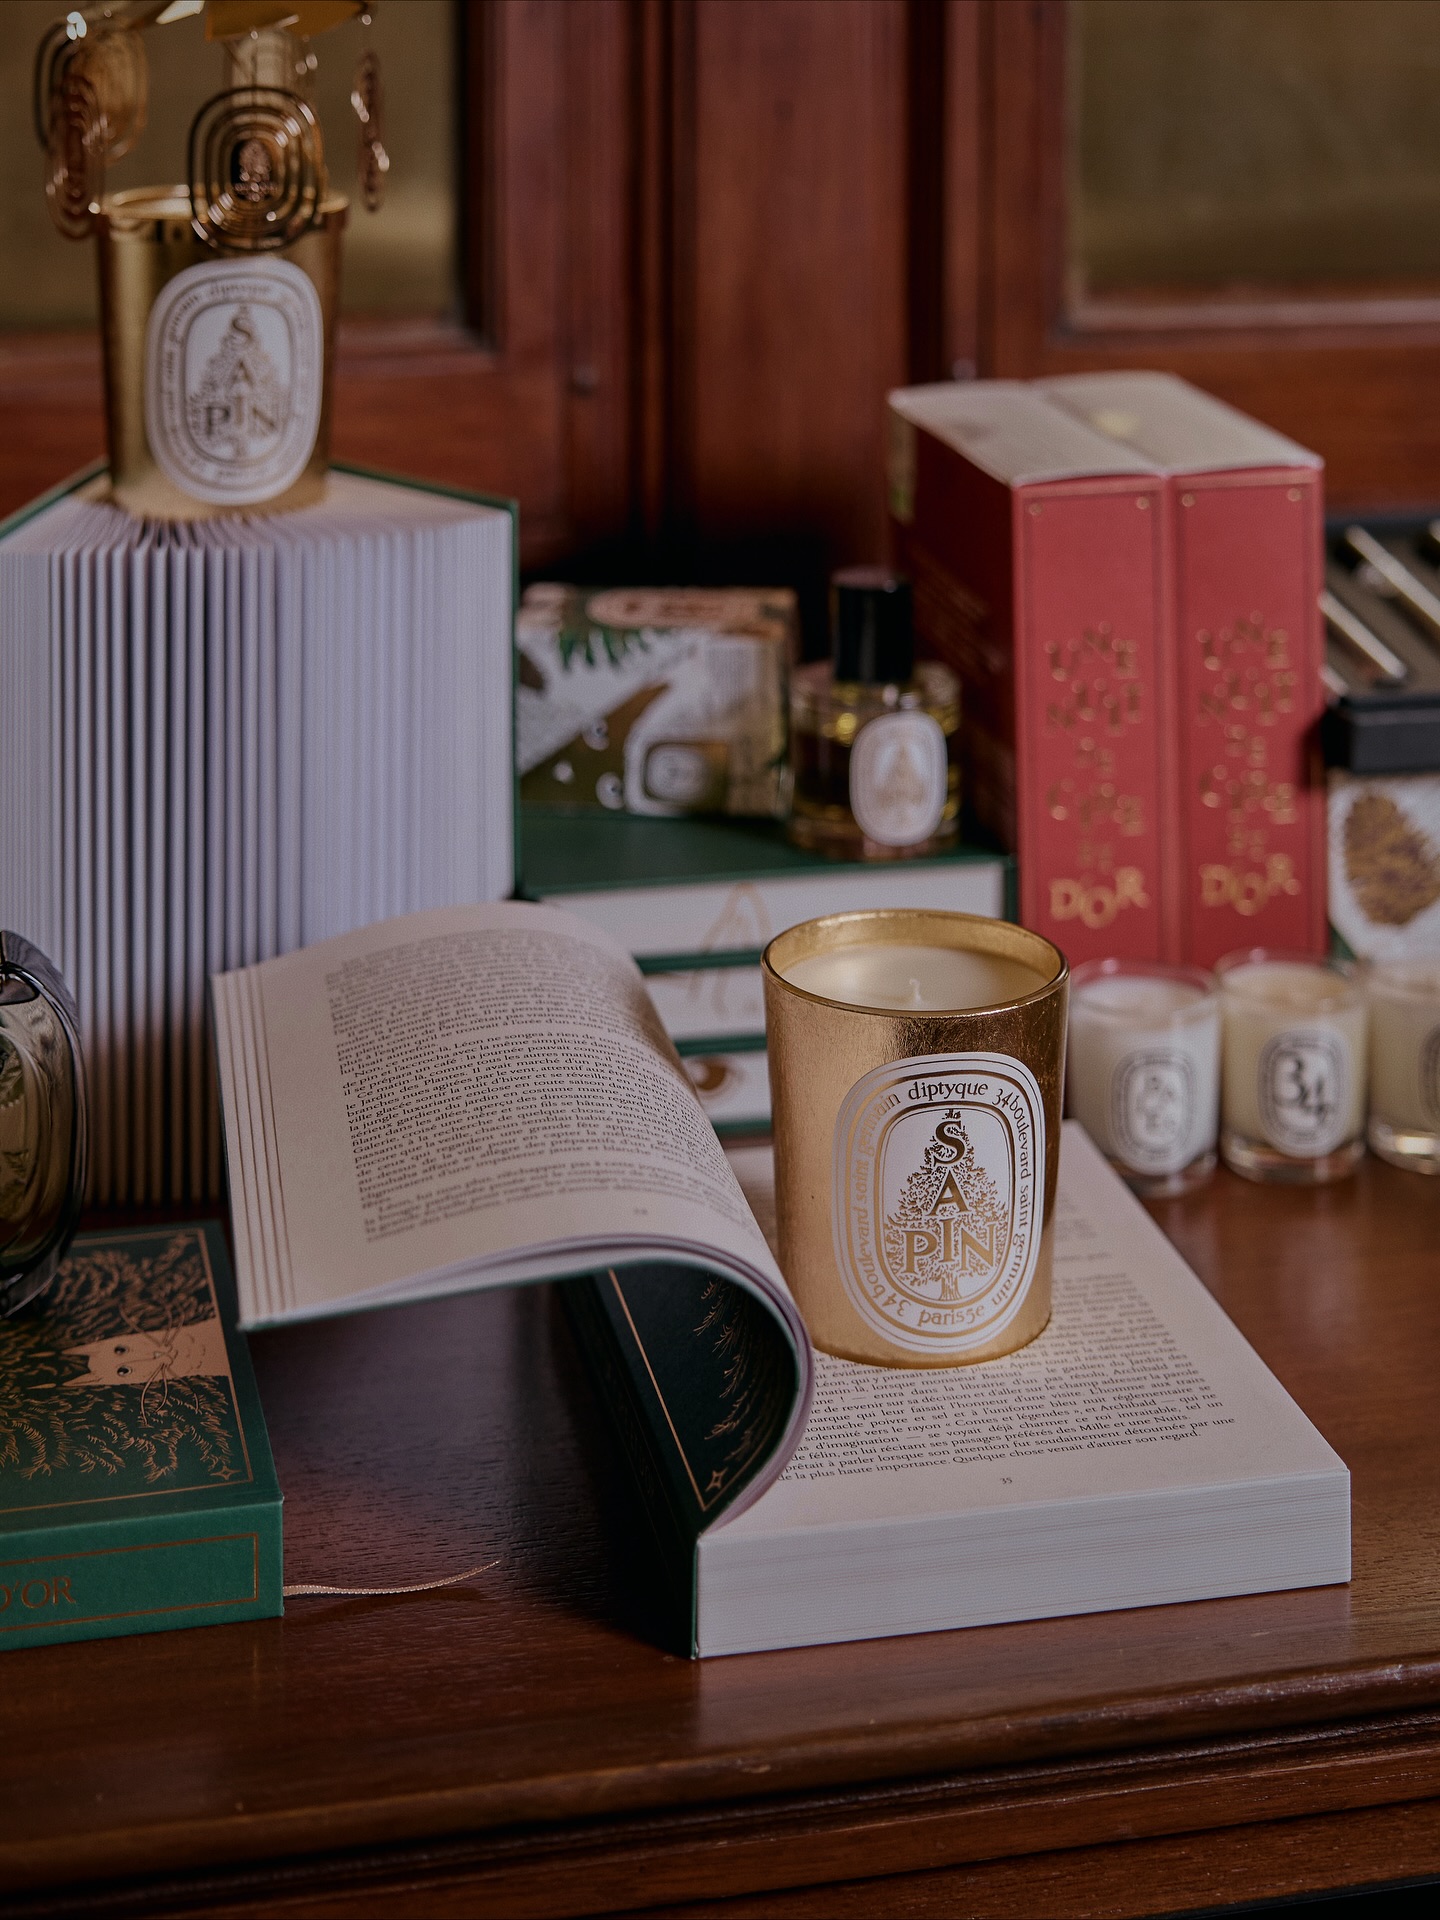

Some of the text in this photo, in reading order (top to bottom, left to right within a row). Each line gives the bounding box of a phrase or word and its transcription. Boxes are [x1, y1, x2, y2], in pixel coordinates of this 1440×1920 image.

[346, 1098, 399, 1115] branches
[402, 1088, 430, 1099] nues
[432, 1077, 472, 1091] agitées
[510, 1066, 539, 1074] vent,
[348, 1113, 372, 1123] ville
[375, 1100, 412, 1116] glacée
[415, 1090, 445, 1103] sortir
[464, 1080, 488, 1091] nuit
[490, 1074, 531, 1085] d'hiver
[363, 1113, 400, 1128] jungle
[403, 1094, 463, 1114] luxuriante
[466, 1084, 511, 1098] enclose
[908, 1081, 989, 1102] diptyque
[348, 1124, 393, 1140] sérieux
[396, 1108, 441, 1125] gardien
[464, 1093, 498, 1106] jardin
[352, 1132, 382, 1146] filant
[385, 1123, 413, 1136] dans
[434, 1108, 470, 1121] allées,
[473, 1099, 513, 1111] aperçu
[859, 1091, 901, 1158] germain
[1019, 1184, 1029, 1229] saint
[902, 1218, 996, 1275] PIN
[991, 1232, 1027, 1306] germain
[804, 1429, 862, 1442] solennité
[906, 1422, 944, 1432] rayon
[954, 1417, 998, 1426] Contes
[1015, 1409, 1069, 1420] légendes
[1098, 1398, 1157, 1411] Archibald
[1178, 1394, 1198, 1405] qui
[814, 1436, 899, 1450] d'imagination
[946, 1426, 981, 1437] voyait
[986, 1422, 1013, 1432] déjà
[1018, 1418, 1069, 1428] charmer
[1094, 1412, 1111, 1420] roi
[1116, 1406, 1181, 1418] intraitable,
[1185, 1403, 1202, 1411] tel
[869, 1417, 908, 1428] poivre
[931, 1411, 947, 1420] sel
[982, 1403, 1044, 1414] l'uniforme
[1049, 1399, 1077, 1407] bleu
[1082, 1395, 1106, 1404] nuit
[1112, 1387, 1192, 1402] réglementaire
[808, 1450, 841, 1459] félin,
[860, 1445, 876, 1454] lui
[879, 1441, 926, 1452] récitant
[950, 1434, 1001, 1446] passages
[1003, 1428, 1053, 1441] préférés
[1079, 1421, 1113, 1431] Mille
[1153, 1414, 1191, 1423] Nuits.
[809, 1469, 834, 1479] plus
[836, 1466, 872, 1474] haute
[874, 1458, 951, 1471] importance.
[951, 1452, 1005, 1464] Quelque
[1008, 1448, 1044, 1457] chose
[1047, 1442, 1084, 1453] venait
[1085, 1438, 1132, 1449] d'attirer
[1159, 1430, 1202, 1442] regard.
[838, 1456, 874, 1467] parler
[877, 1451, 924, 1461] lorsque
[953, 1442, 1013, 1453] attention
[1033, 1430, 1120, 1445] soudainement
[1123, 1423, 1186, 1436] détournée
[1189, 1422, 1209, 1431] par
